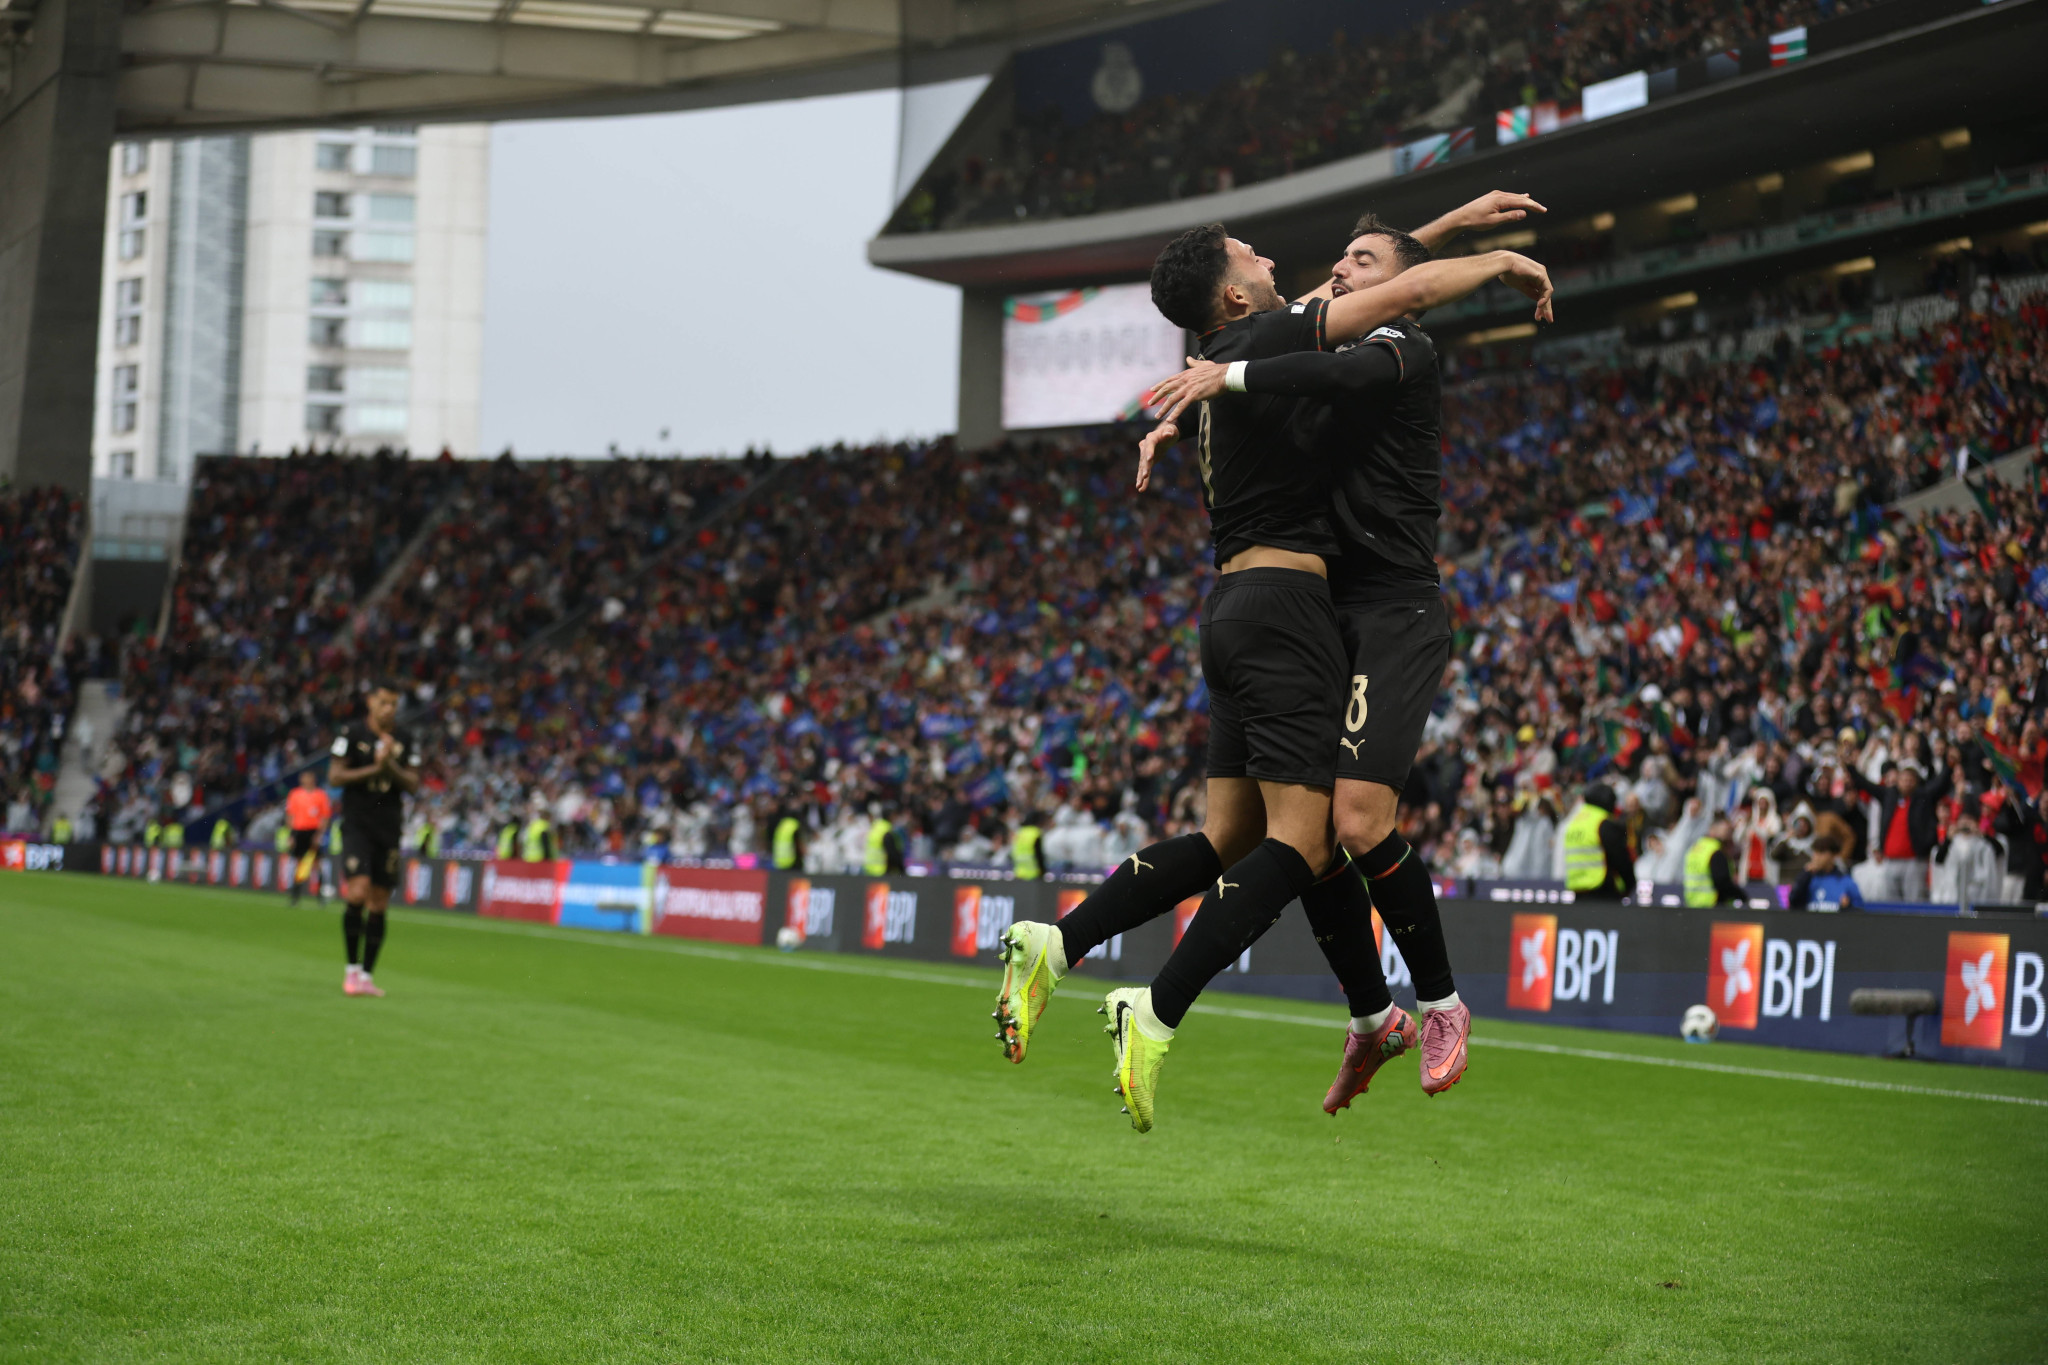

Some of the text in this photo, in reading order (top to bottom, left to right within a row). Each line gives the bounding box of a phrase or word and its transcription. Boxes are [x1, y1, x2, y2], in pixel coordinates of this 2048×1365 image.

[1345, 674, 1369, 732] 8
[804, 887, 836, 938] BPI
[882, 891, 917, 944] BPI
[1554, 928, 1618, 1004] BPI
[1762, 939, 1837, 1022] BPI
[2009, 951, 2048, 1037] B
